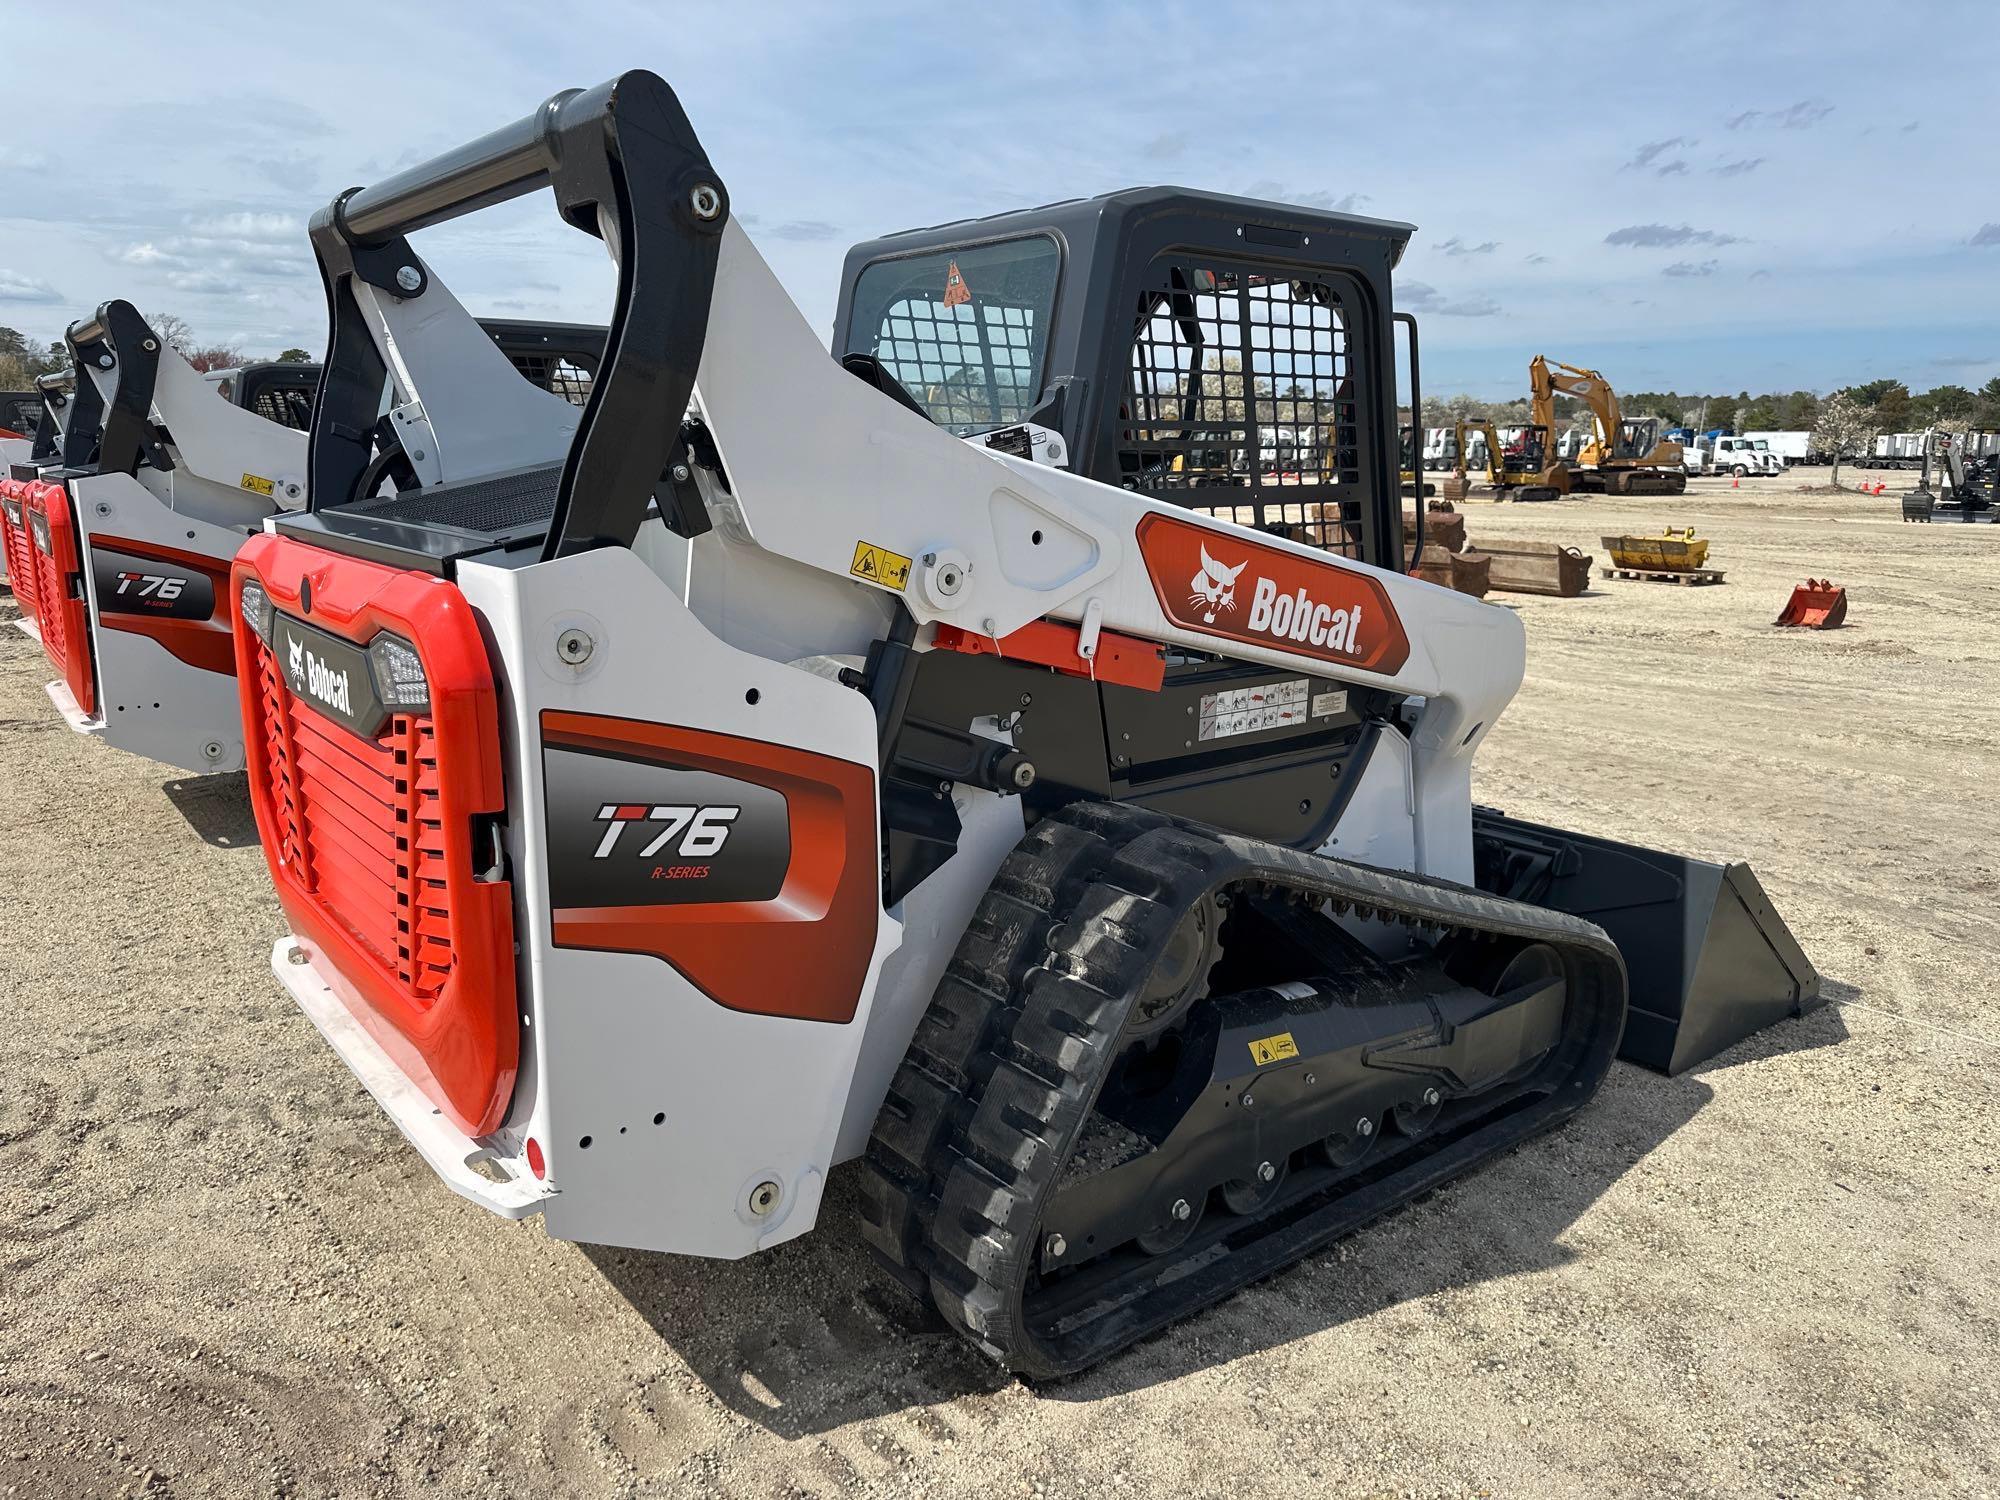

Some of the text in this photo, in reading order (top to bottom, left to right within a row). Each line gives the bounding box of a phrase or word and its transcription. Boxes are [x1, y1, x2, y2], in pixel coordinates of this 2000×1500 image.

[117, 572, 187, 600] T76
[1248, 577, 1362, 654] Bobcat
[306, 651, 354, 717] Bobcat
[594, 806, 739, 857] T76
[651, 866, 711, 879] R-SERIES
